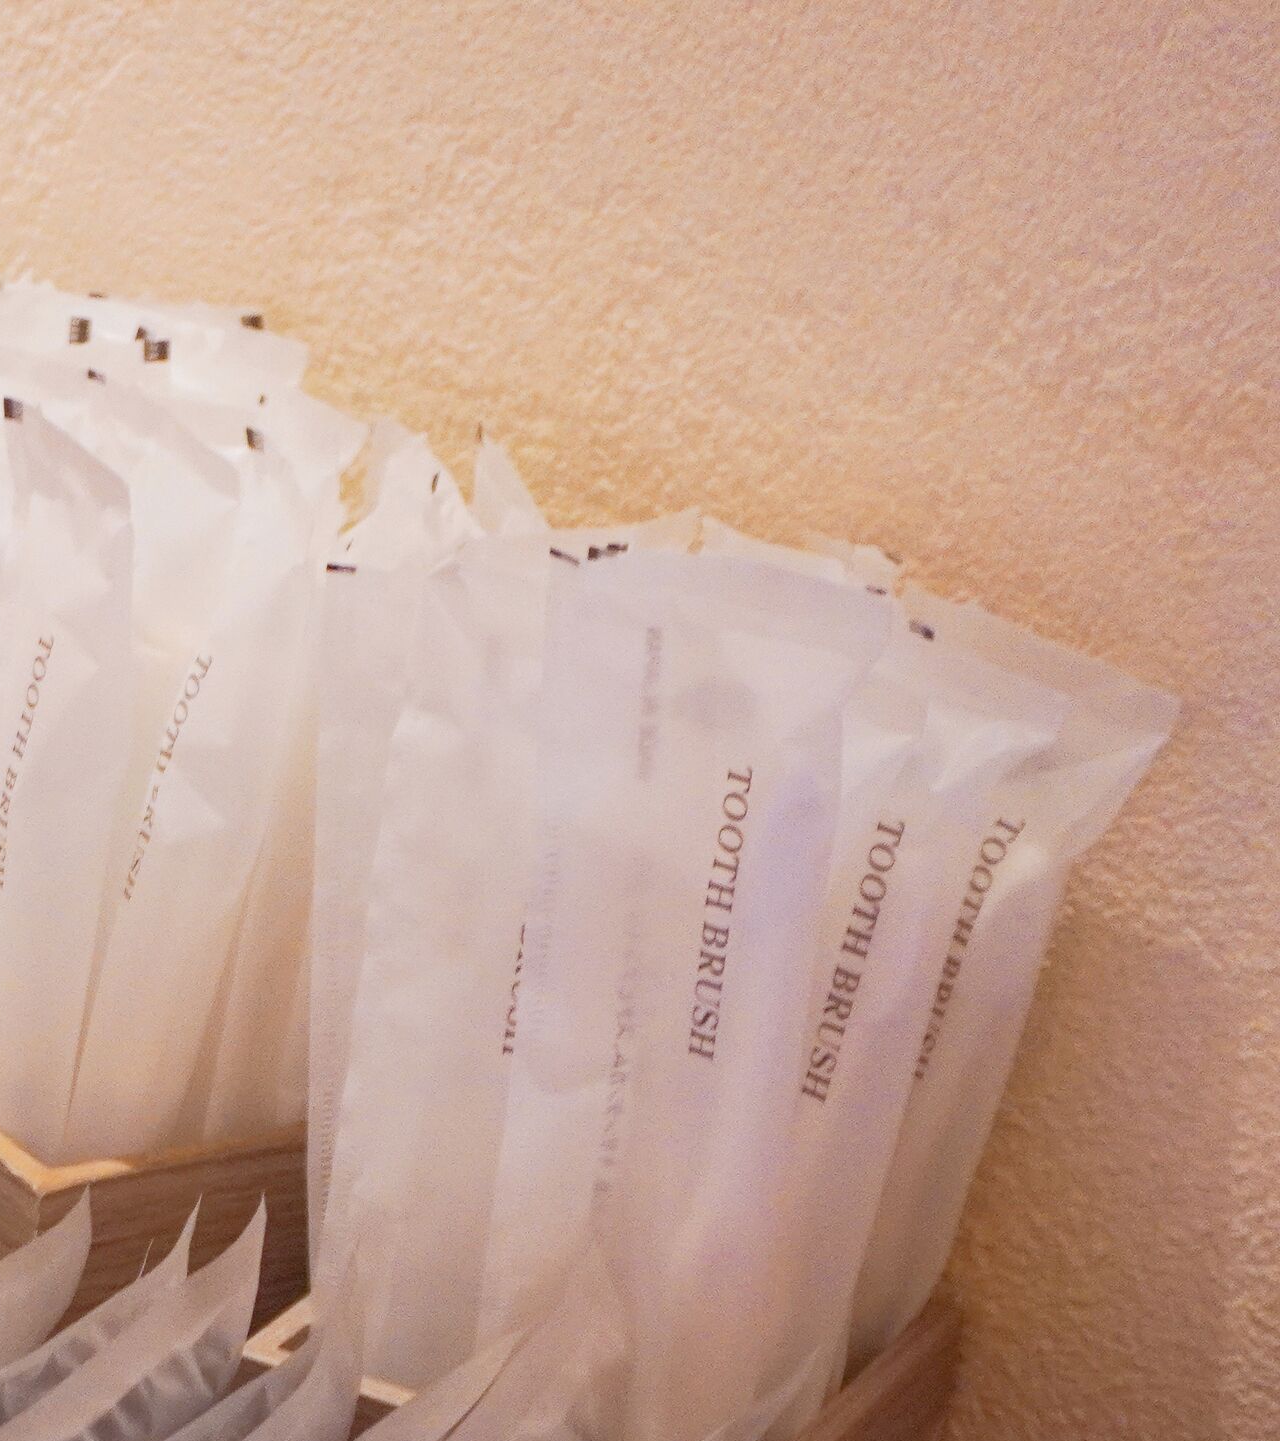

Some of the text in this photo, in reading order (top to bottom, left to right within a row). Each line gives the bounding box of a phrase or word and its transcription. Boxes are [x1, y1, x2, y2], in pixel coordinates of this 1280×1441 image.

[12, 635, 54, 760] TOOTH
[688, 765, 754, 1062] TOOTH BRUSH
[800, 820, 906, 1105] TOOTH BRUSH
[952, 817, 1027, 948] TOOTH
